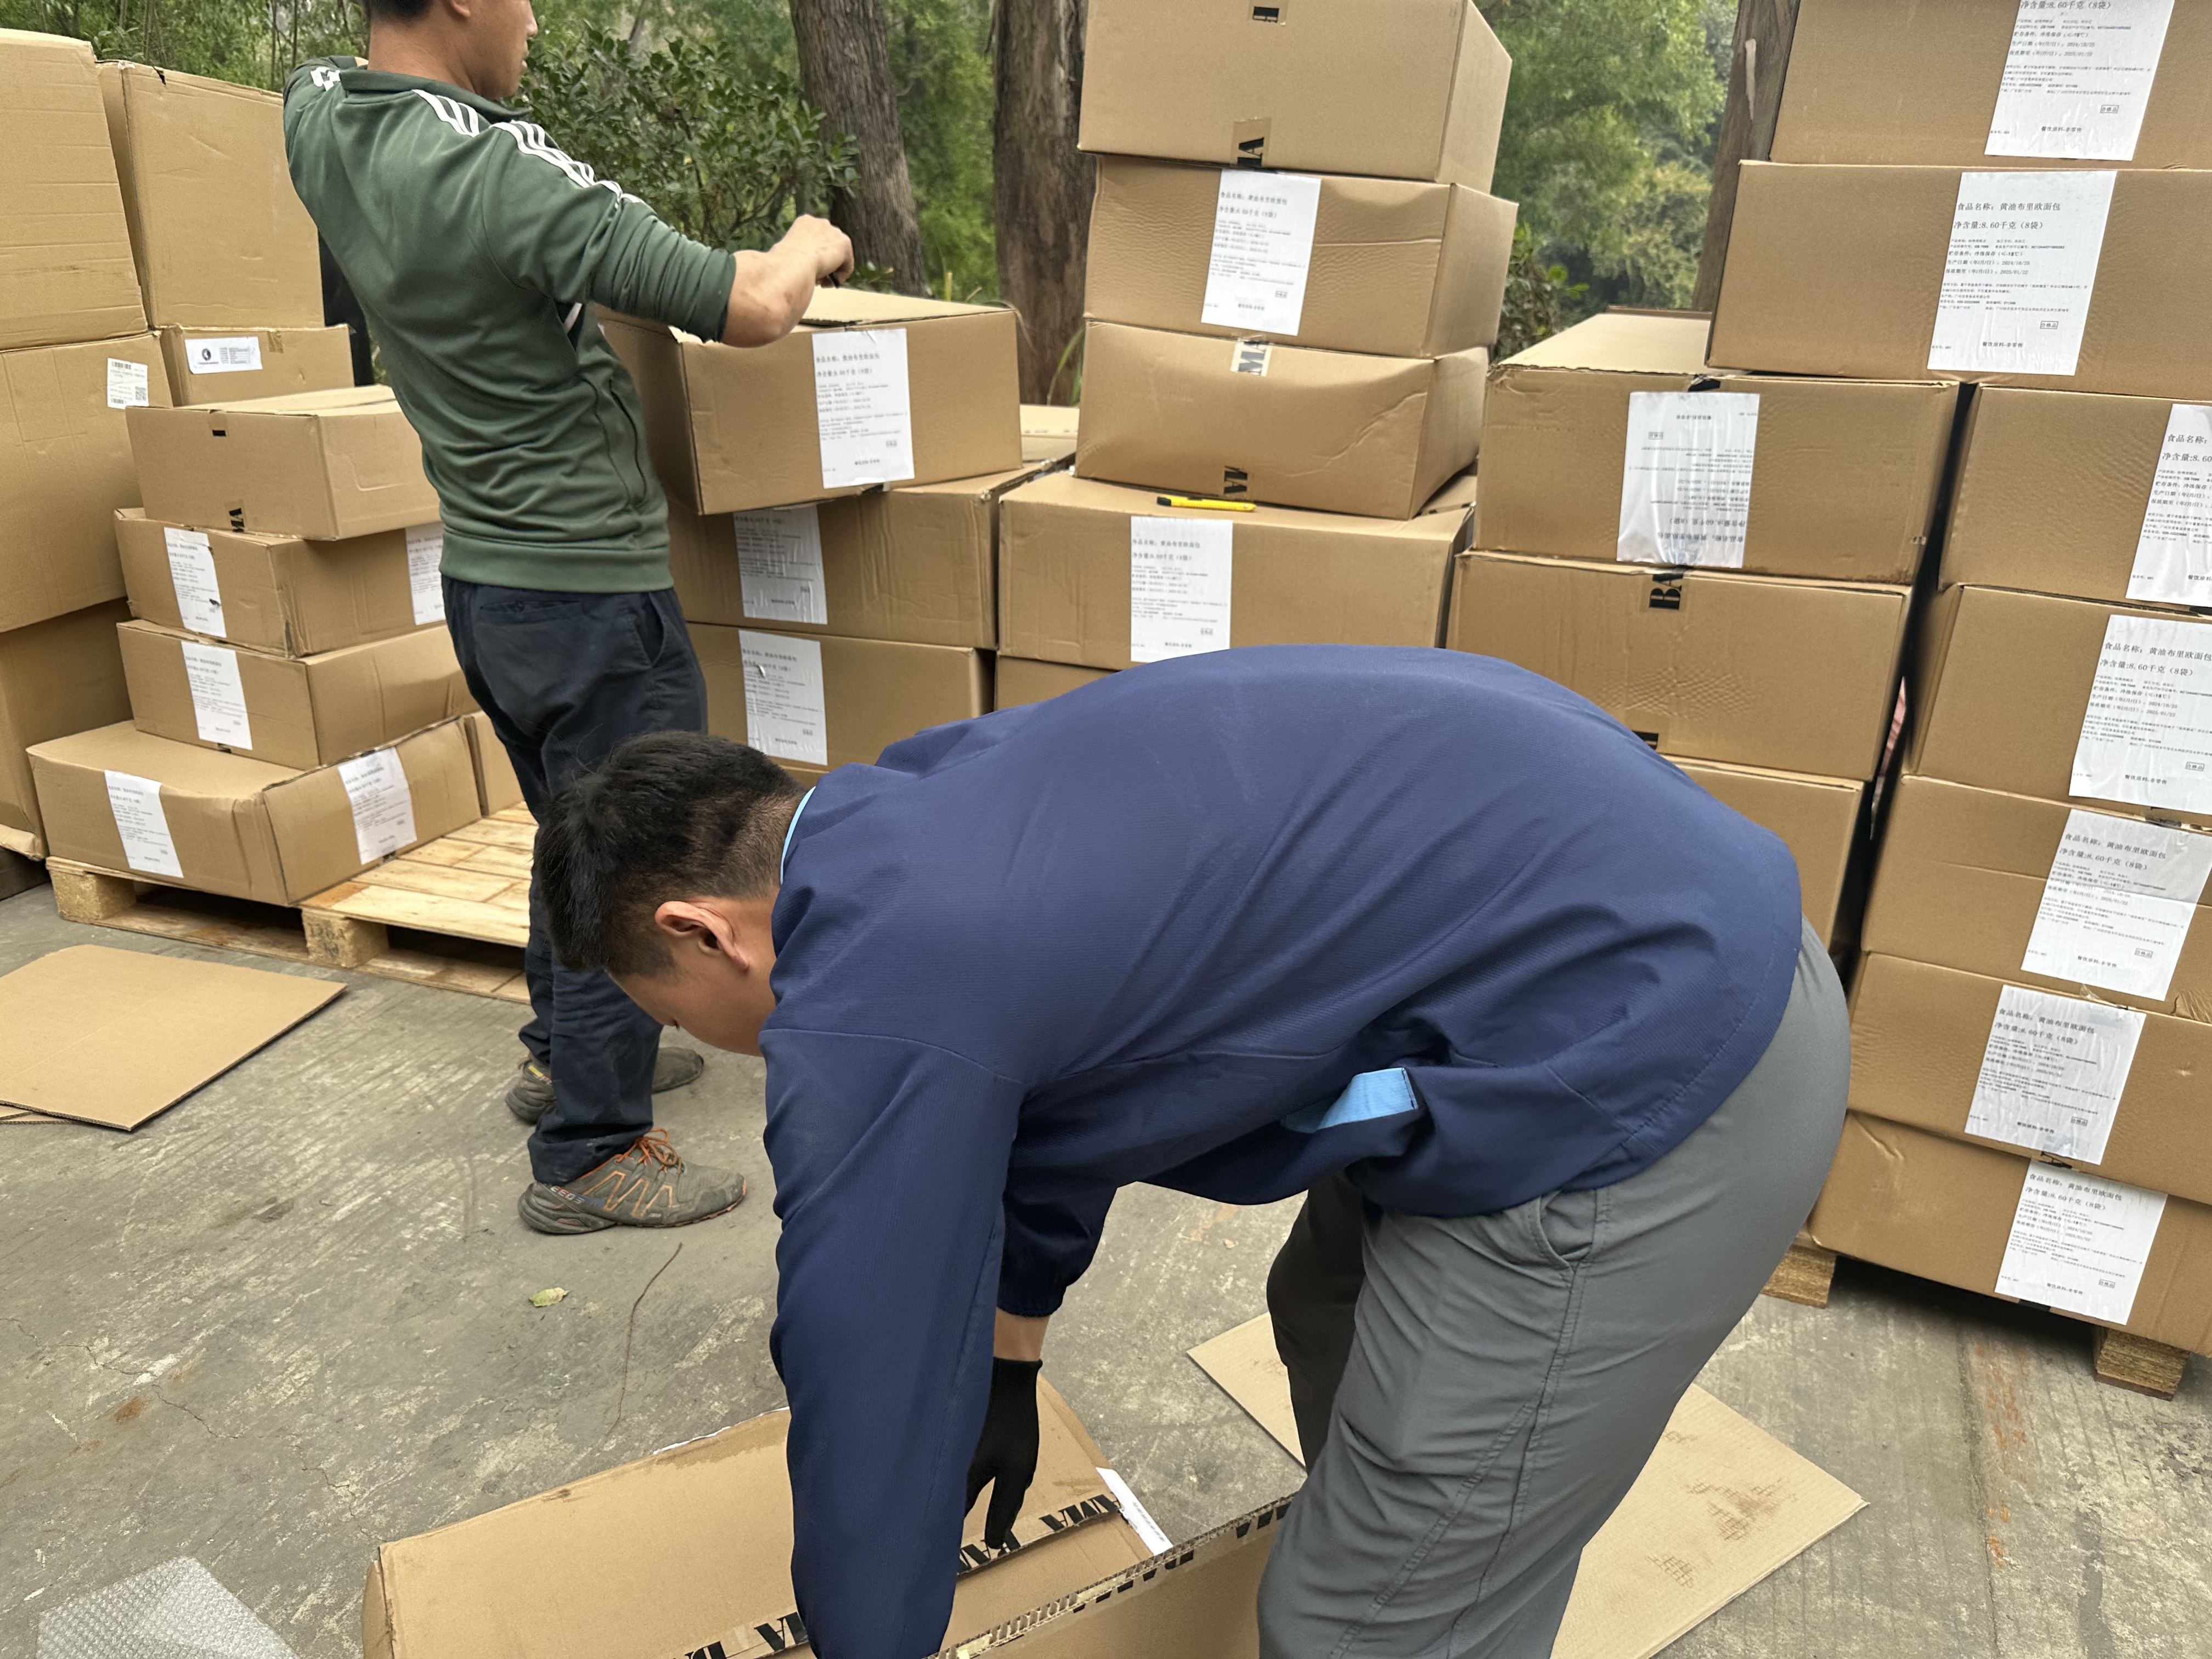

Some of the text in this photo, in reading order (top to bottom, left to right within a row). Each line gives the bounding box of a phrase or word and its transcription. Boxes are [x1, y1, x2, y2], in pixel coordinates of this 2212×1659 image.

[1957, 202, 2061, 212] 食品名称：黄油布里欧面包
[1954, 221, 2044, 230] 净含量:8.60千克（8袋）
